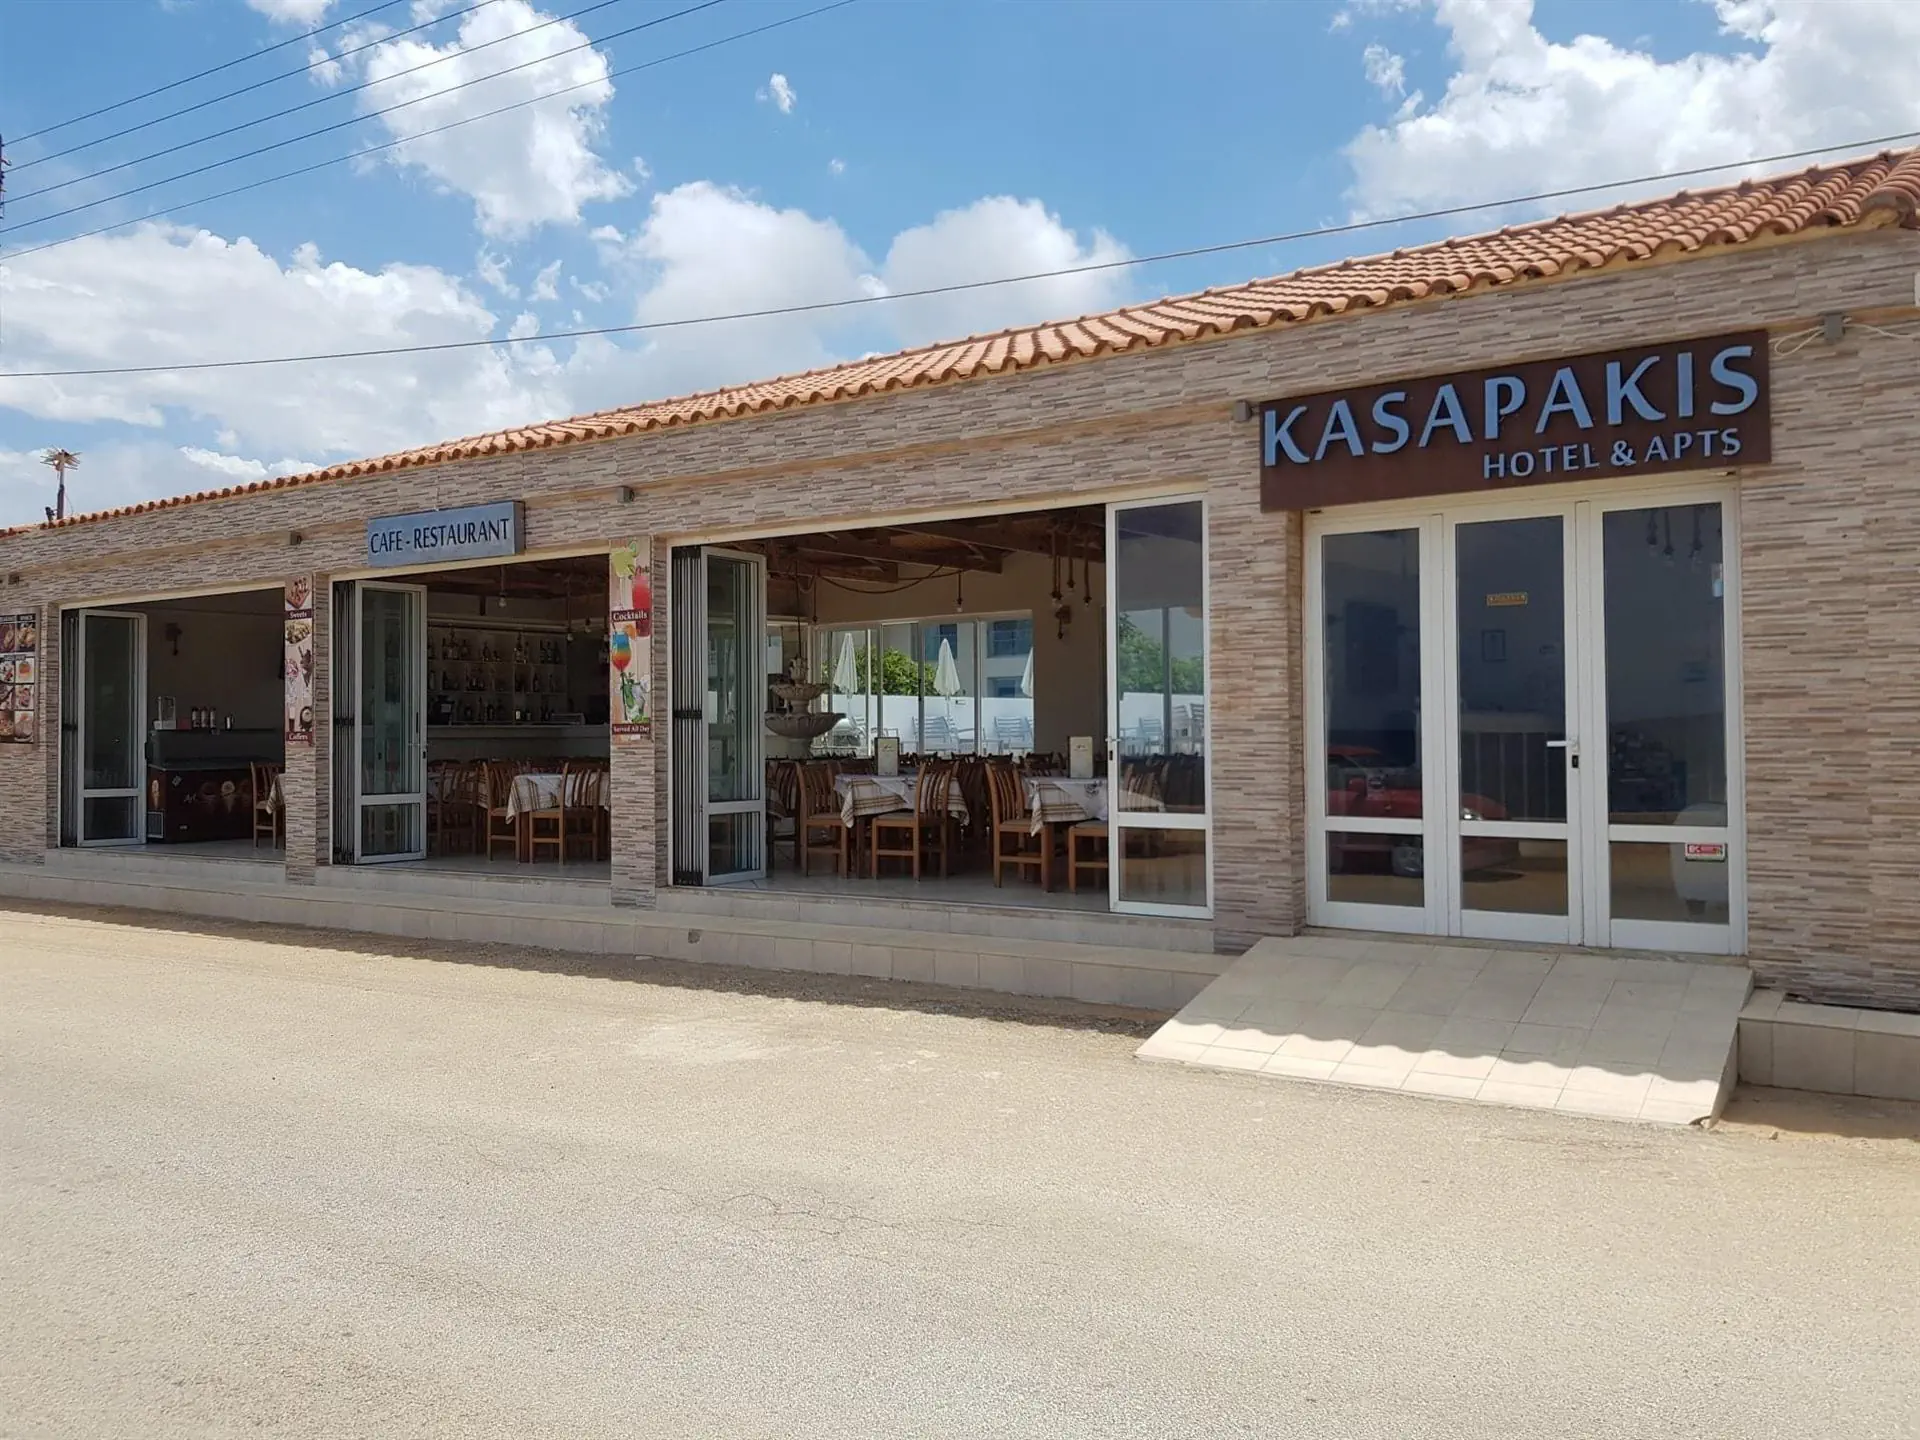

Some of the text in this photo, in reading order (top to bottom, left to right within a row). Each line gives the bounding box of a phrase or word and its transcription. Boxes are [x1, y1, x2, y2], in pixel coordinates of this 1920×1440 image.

[1263, 345, 1760, 467] KASAPAKIS
[1483, 428, 1742, 479] HOTEL & APTS
[370, 530, 403, 554] CAFE
[413, 518, 510, 549] RESTAURANT
[613, 611, 648, 621] Cocktails
